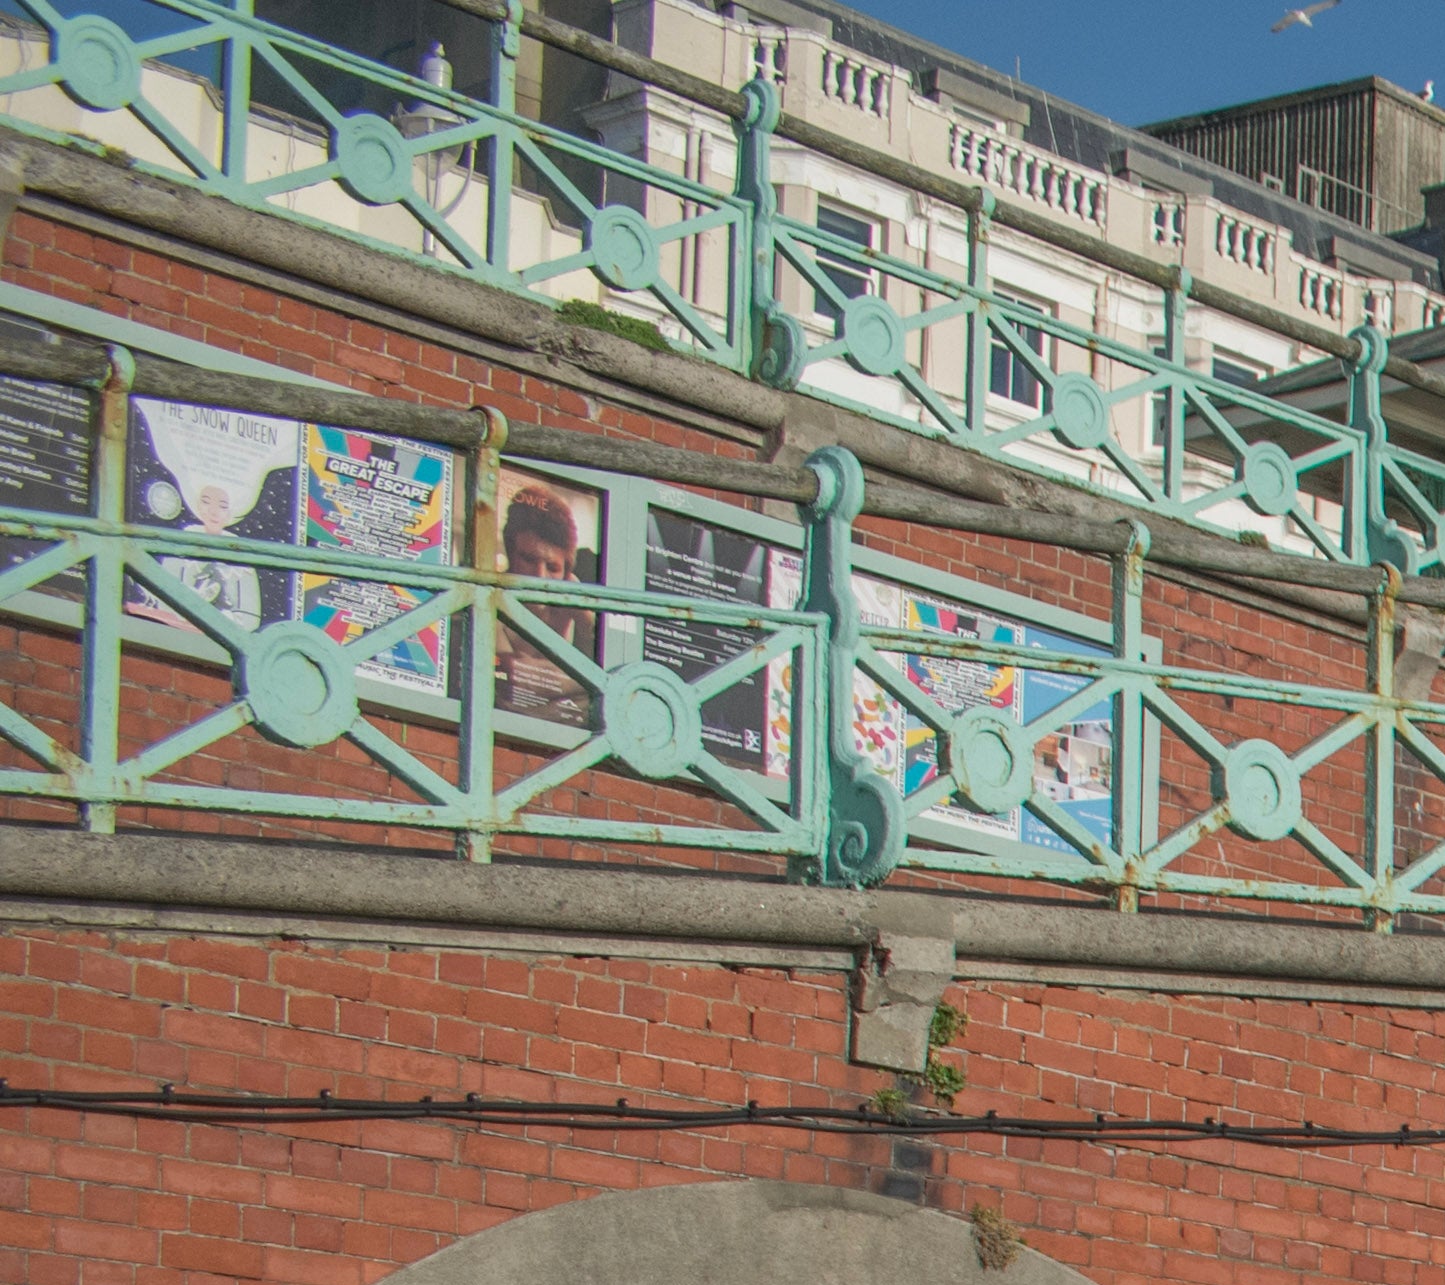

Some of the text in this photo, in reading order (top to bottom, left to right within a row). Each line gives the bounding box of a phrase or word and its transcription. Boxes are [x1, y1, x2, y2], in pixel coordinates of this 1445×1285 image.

[191, 406, 230, 433] SNOW
[236, 416, 278, 446] QUEEN
[328, 459, 377, 482] GREAT
[369, 456, 397, 473] THE
[373, 478, 431, 503] ESCAPE
[358, 662, 381, 676] USIC,
